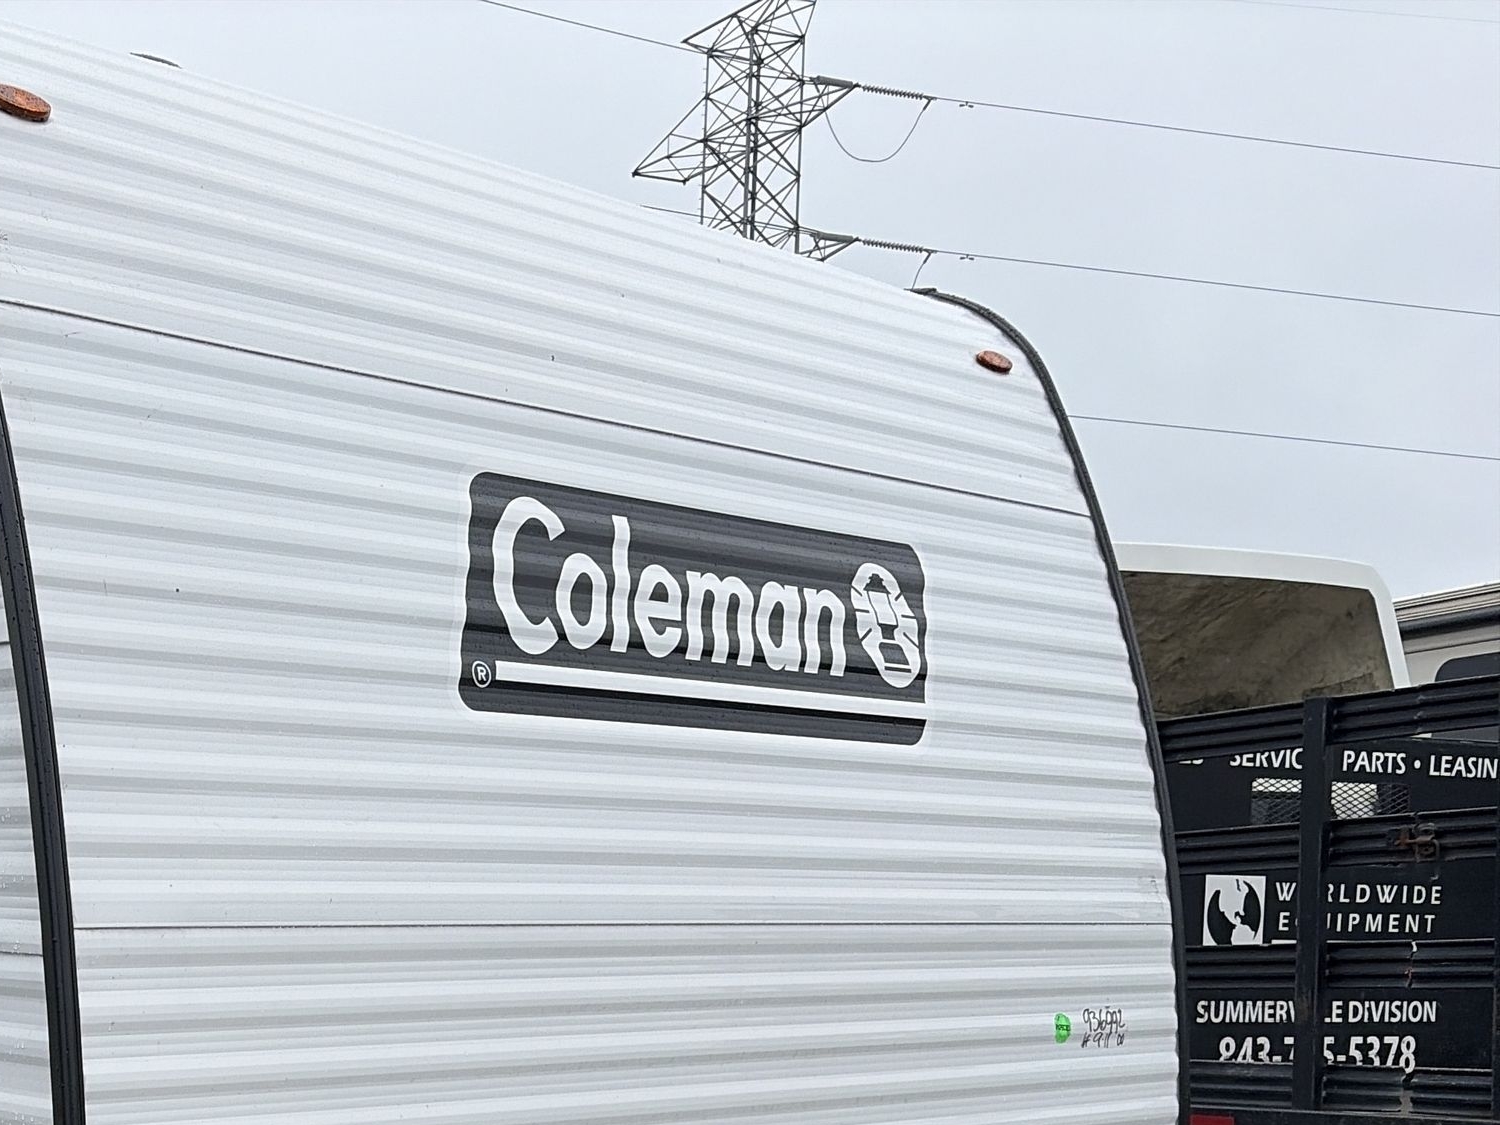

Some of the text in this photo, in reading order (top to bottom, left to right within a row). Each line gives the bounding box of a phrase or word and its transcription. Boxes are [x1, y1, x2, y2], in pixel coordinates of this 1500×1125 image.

[492, 497, 846, 677] Coleman
[1229, 747, 1499, 779] SERVIC PARTS LEASIN
[1275, 881, 1442, 905] WRLDWIDE
[1278, 911, 1436, 934] EIPMENT
[1196, 1000, 1437, 1024] SUMMERVE DIVISION
[1219, 1035, 1416, 1074] 843-75-5378
